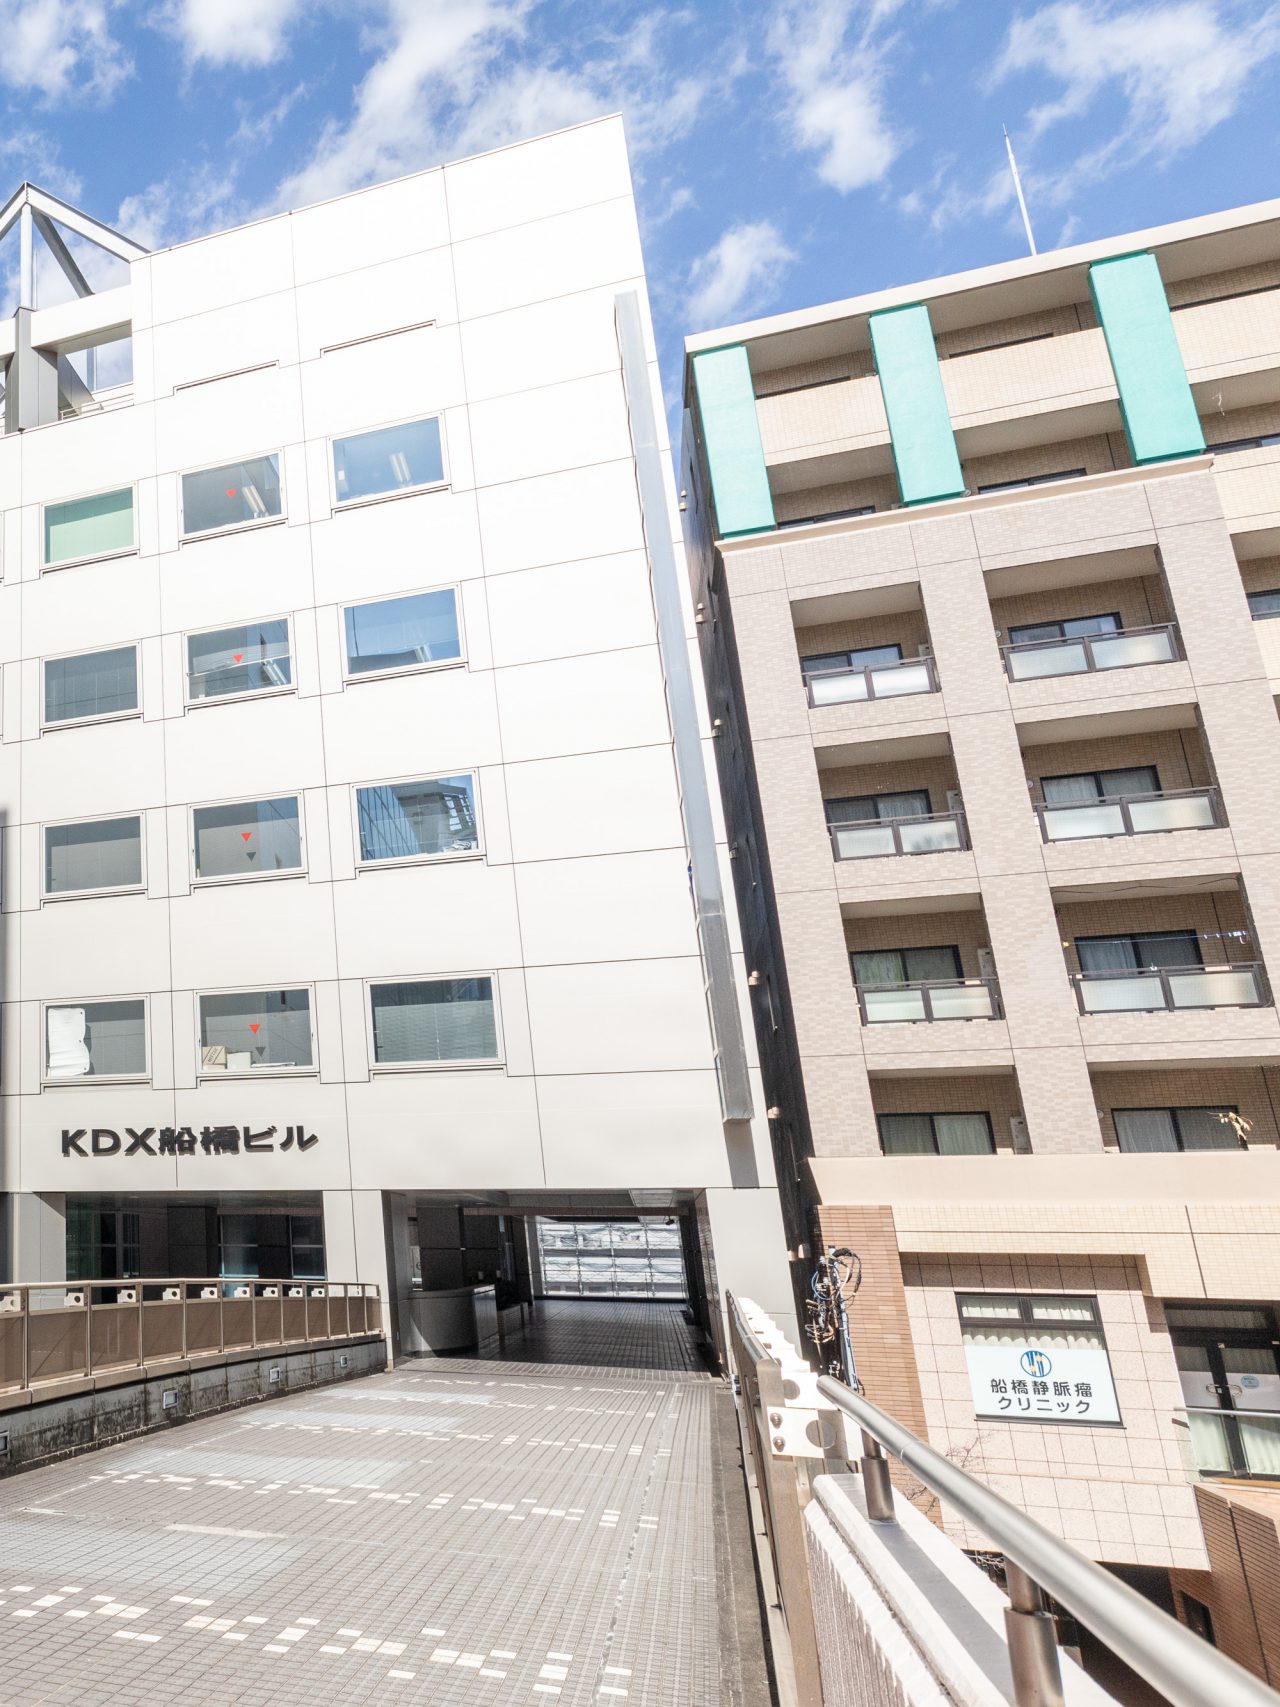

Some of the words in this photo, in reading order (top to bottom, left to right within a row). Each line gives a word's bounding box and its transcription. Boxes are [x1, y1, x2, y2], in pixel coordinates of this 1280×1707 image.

[61, 1126, 318, 1156] KDX船橋ビル
[990, 1378, 1092, 1398] 船橋静脈瘤
[998, 1396, 1091, 1414] クリニック
